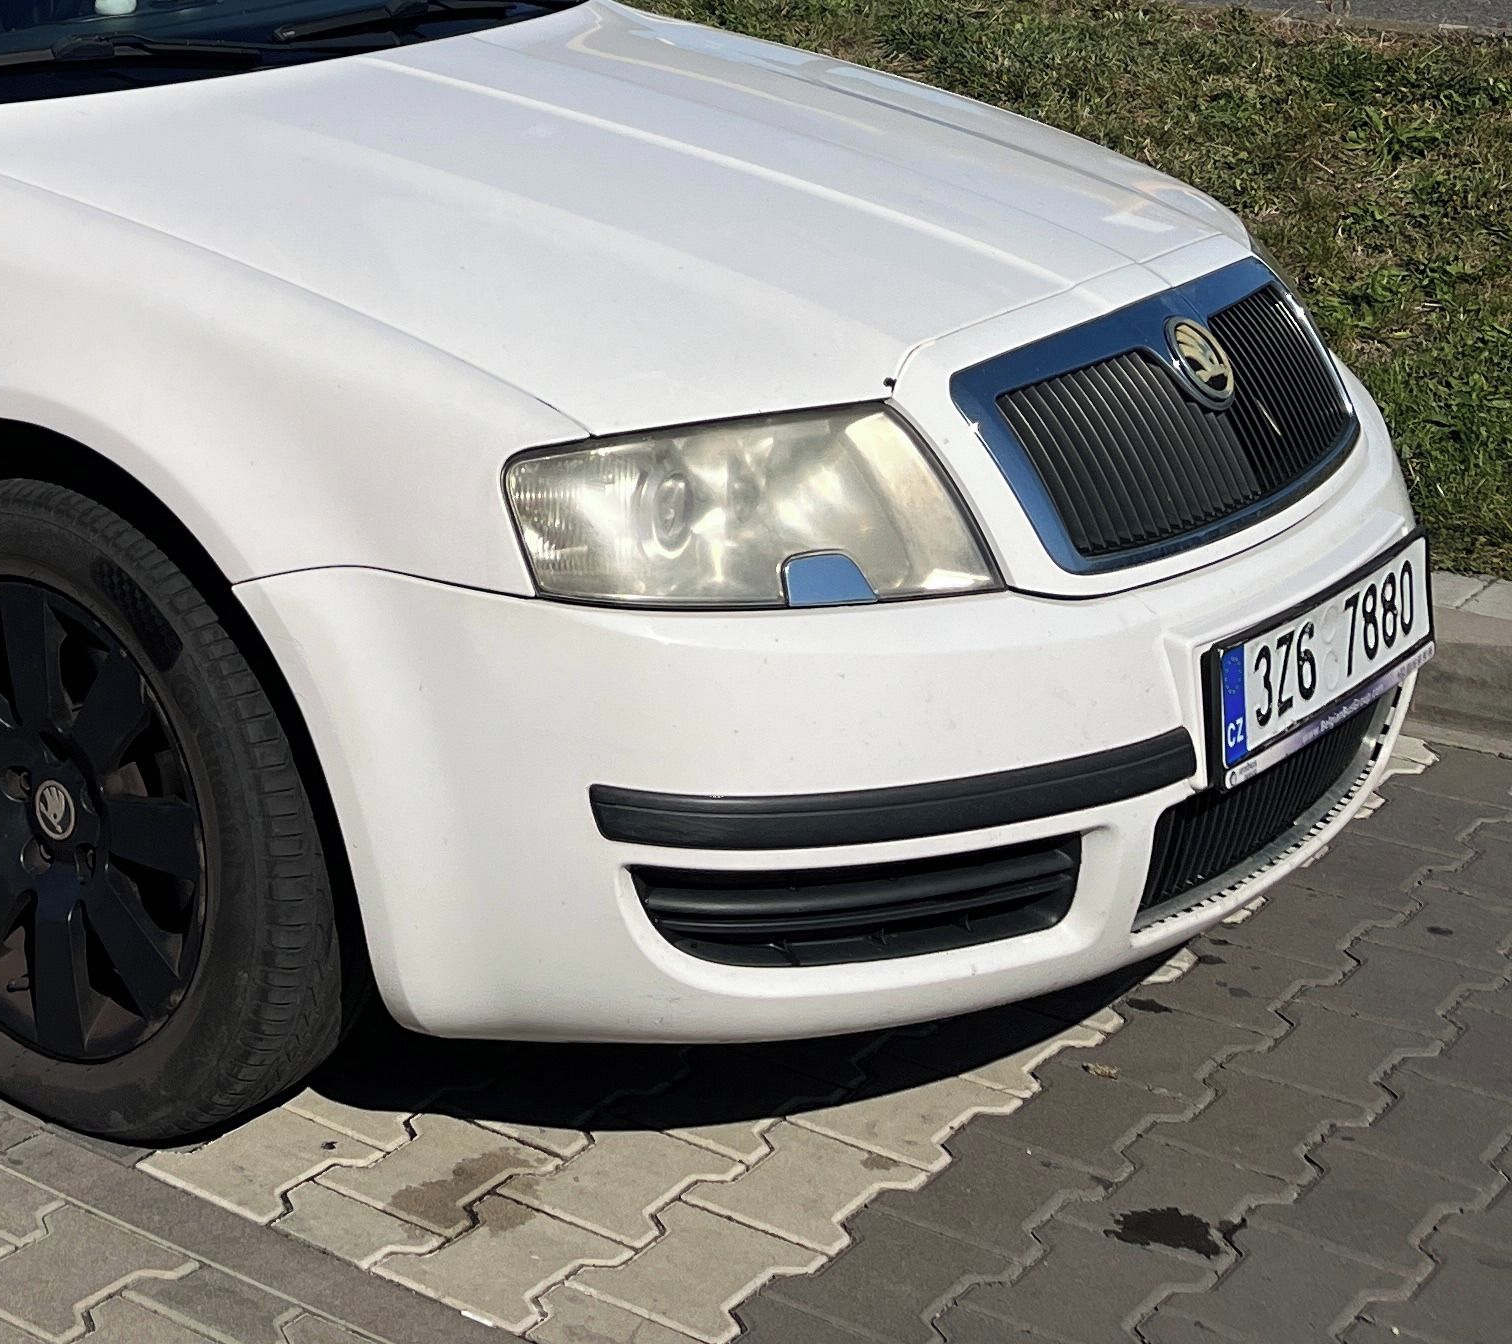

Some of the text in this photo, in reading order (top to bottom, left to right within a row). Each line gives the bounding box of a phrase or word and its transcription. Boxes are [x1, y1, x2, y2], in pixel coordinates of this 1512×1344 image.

[1254, 560, 1414, 726] 3Z6 7880
[1227, 717, 1244, 747] CZ
